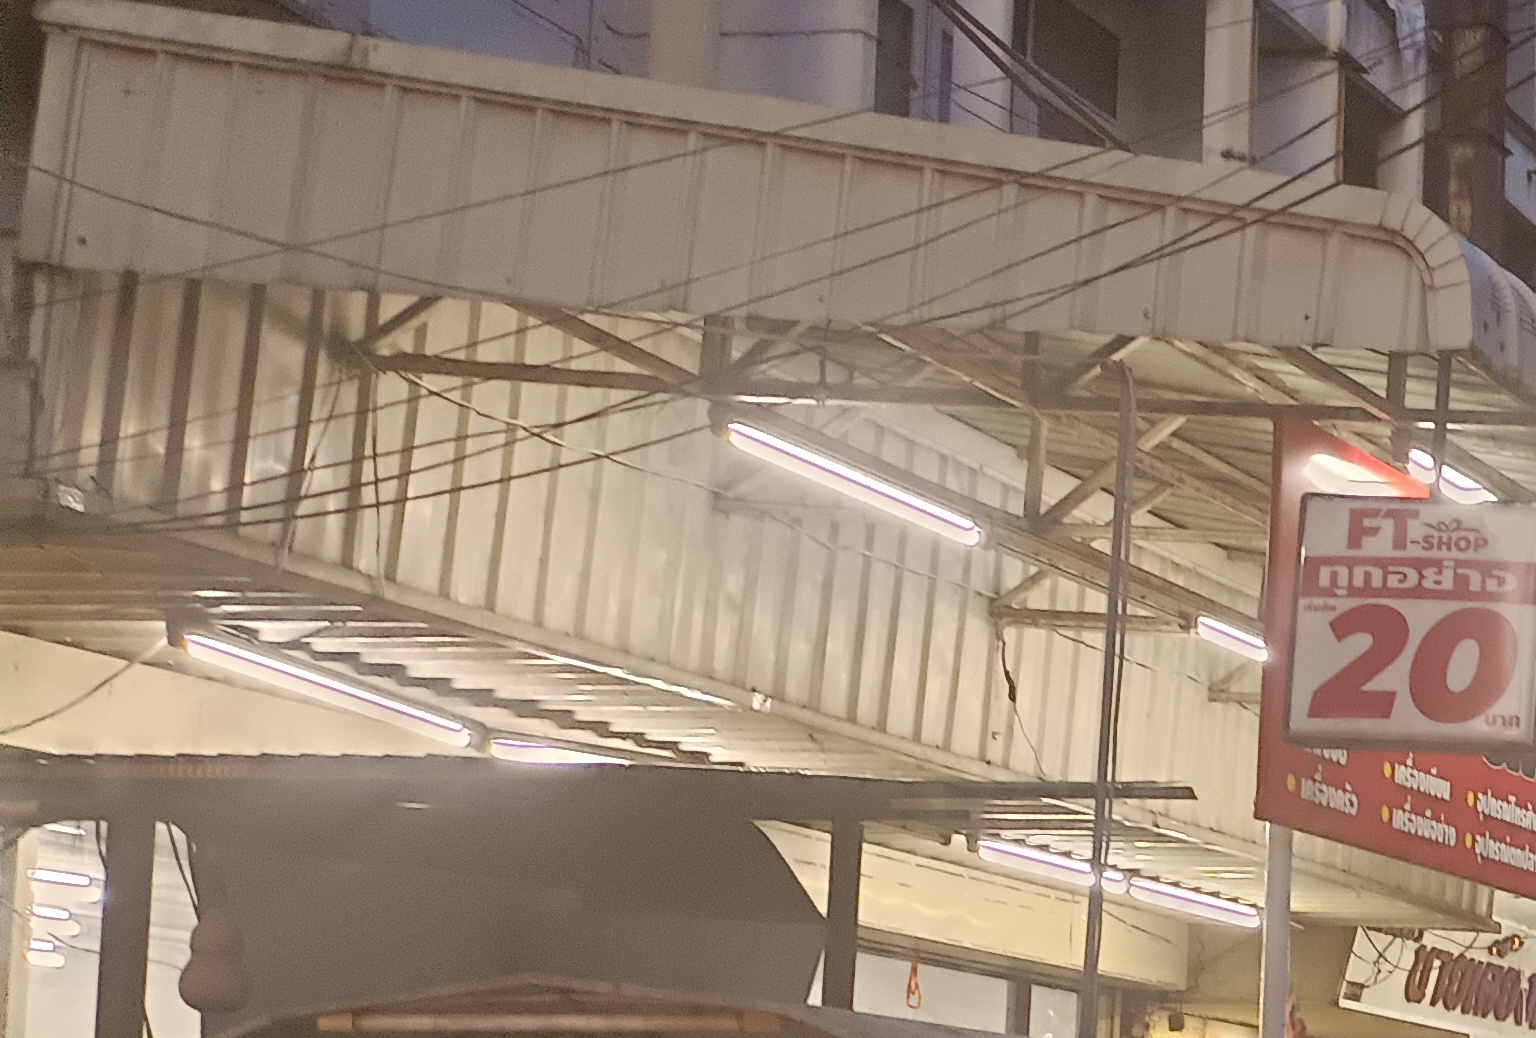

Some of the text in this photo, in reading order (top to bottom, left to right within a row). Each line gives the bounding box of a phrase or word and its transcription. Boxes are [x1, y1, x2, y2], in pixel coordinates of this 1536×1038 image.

[1318, 560, 1518, 597] ทุกอย่าง
[1307, 603, 1518, 724] 20
